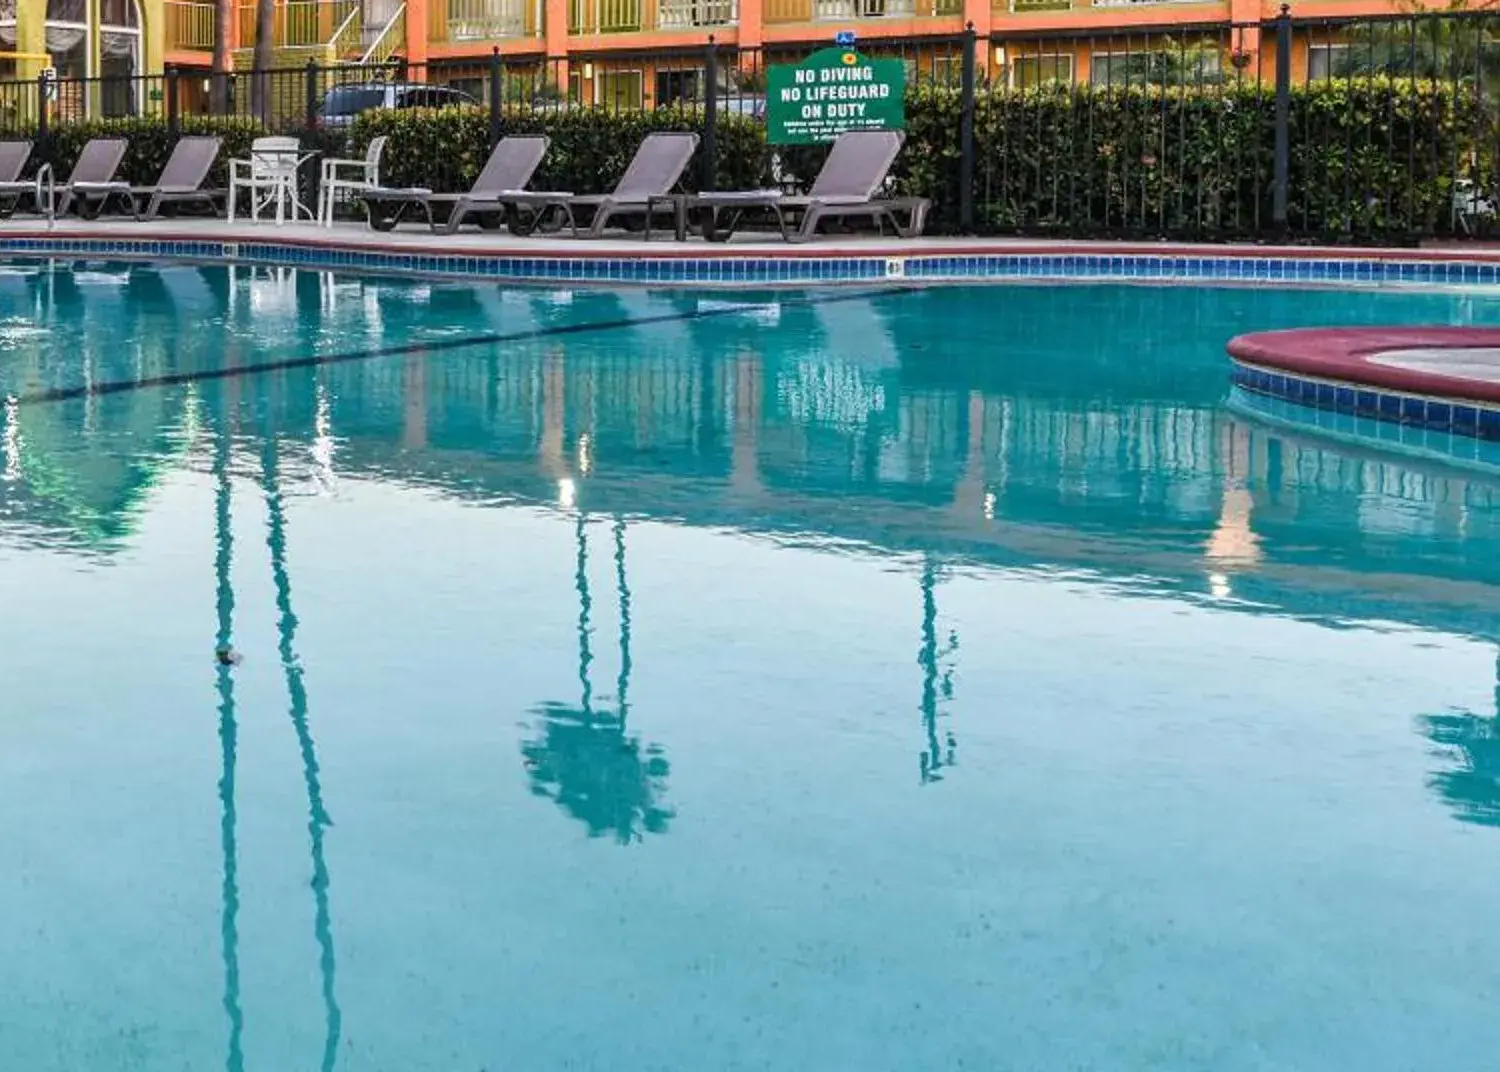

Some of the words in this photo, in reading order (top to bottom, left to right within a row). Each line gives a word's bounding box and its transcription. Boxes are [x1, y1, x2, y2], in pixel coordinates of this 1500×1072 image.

[795, 69, 815, 83] NO
[820, 66, 873, 83] DIVING
[781, 87, 801, 102] NO
[806, 83, 889, 101] LIFEGUARD
[801, 104, 822, 119] ON
[827, 103, 866, 117] DUTY
